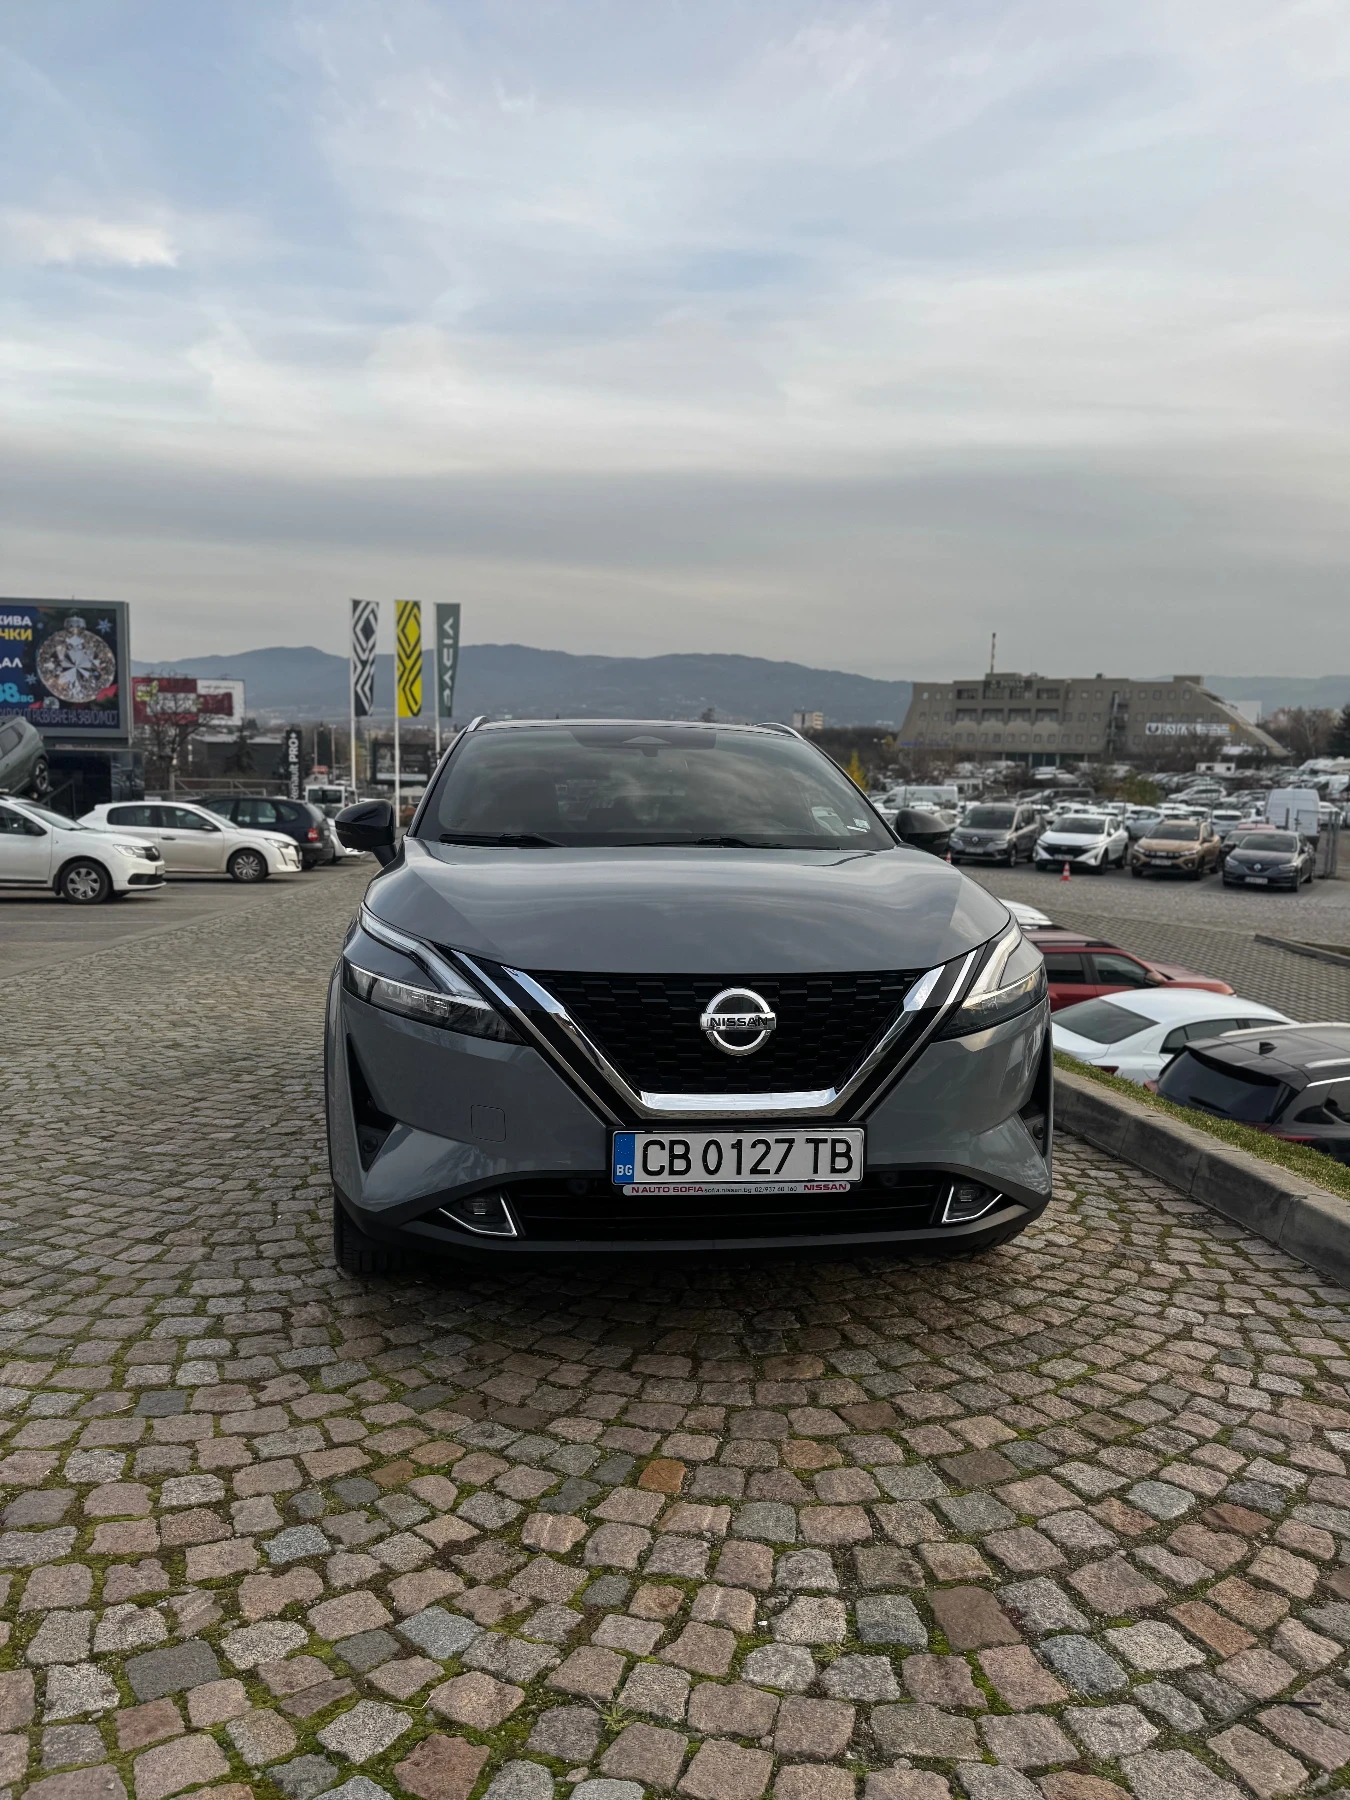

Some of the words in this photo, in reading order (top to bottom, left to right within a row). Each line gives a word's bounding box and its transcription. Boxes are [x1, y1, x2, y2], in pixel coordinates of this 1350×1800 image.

[0, 657, 23, 669] АЛ
[443, 616, 454, 707] DACIA
[709, 1017, 768, 1026] NISSAN
[642, 1139, 692, 1176] CB
[702, 1138, 795, 1175] 0127
[805, 1137, 853, 1174] TB
[616, 1165, 633, 1176] BG
[803, 1183, 847, 1191] NISSAN
